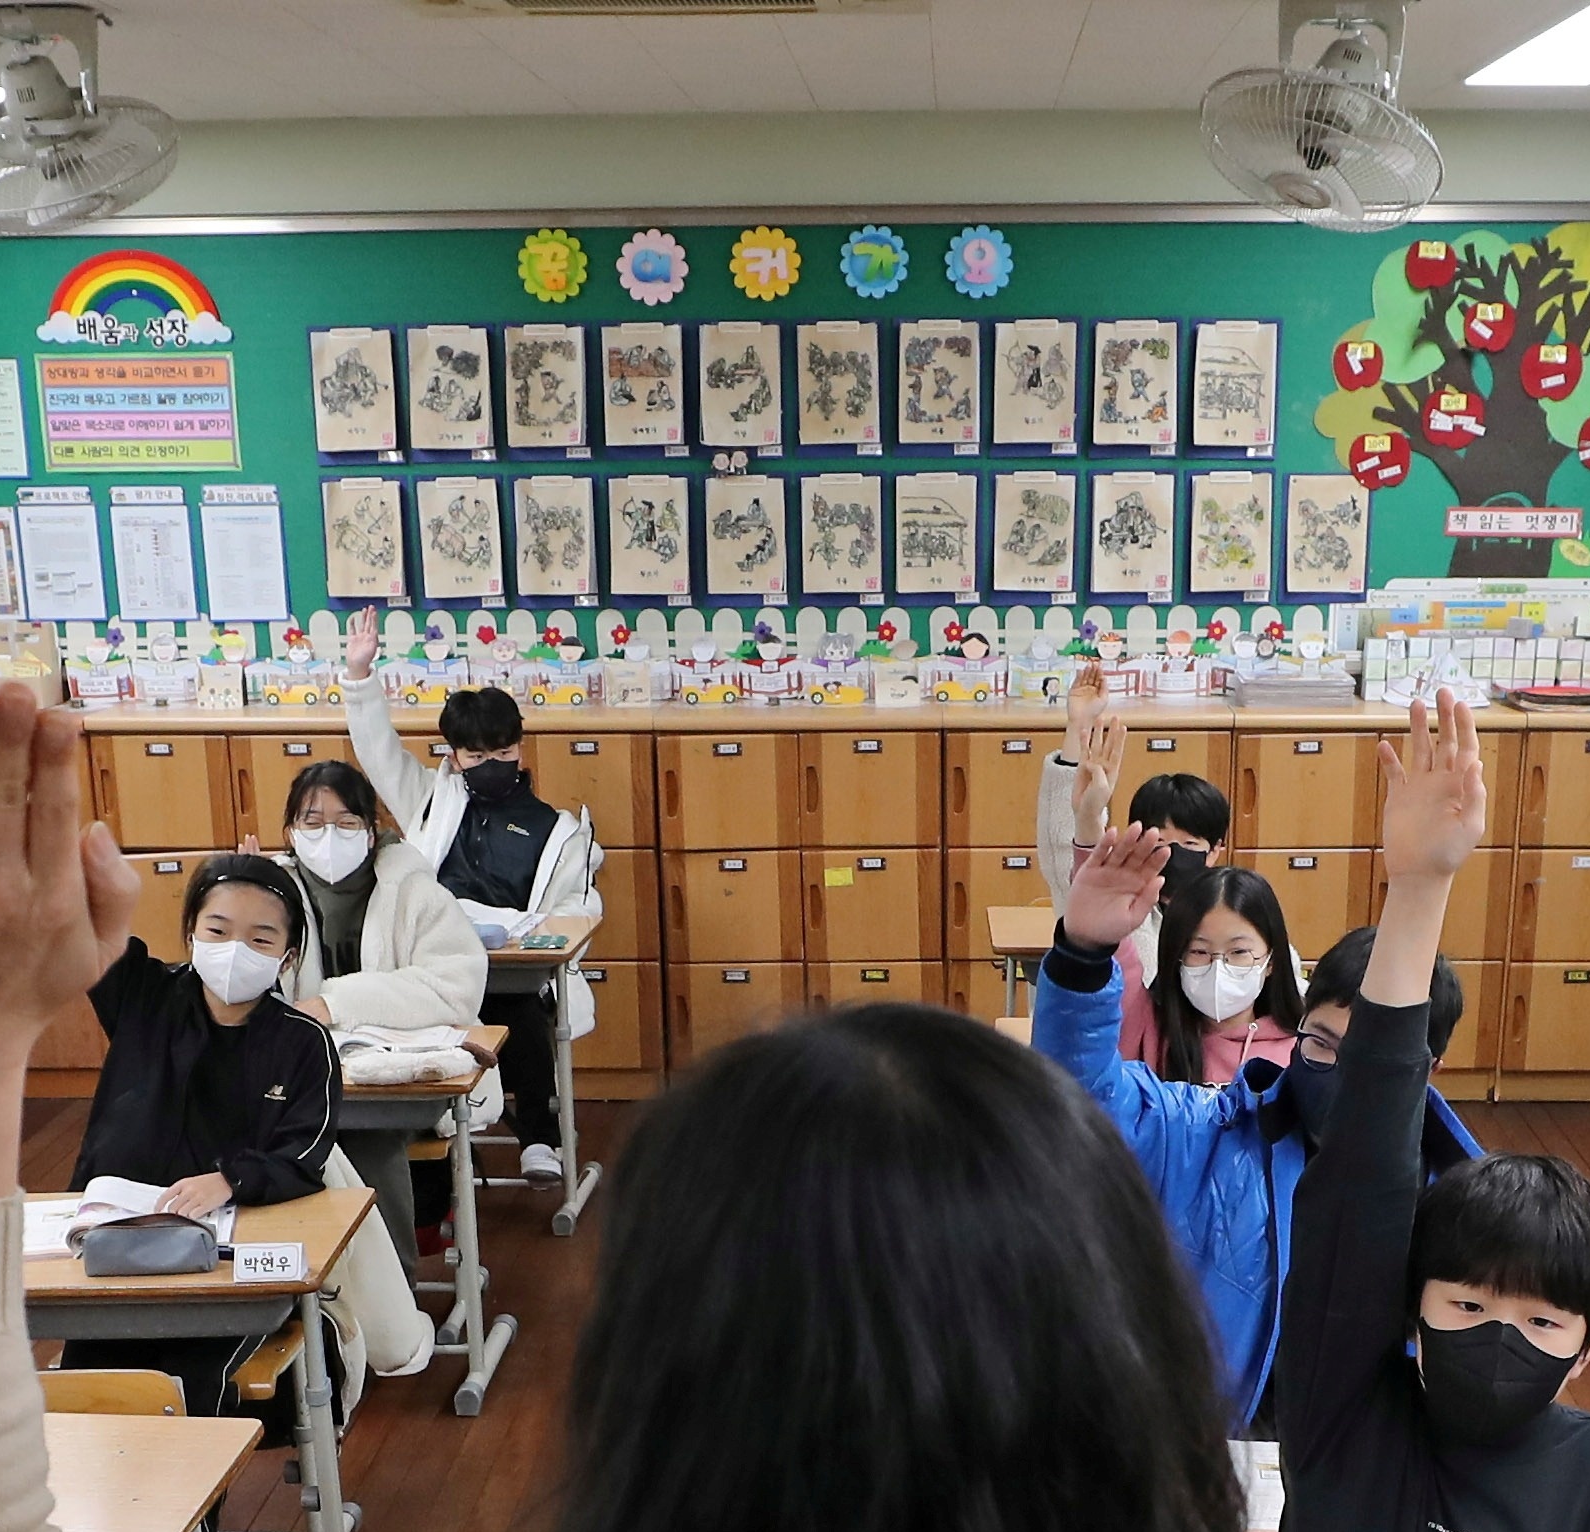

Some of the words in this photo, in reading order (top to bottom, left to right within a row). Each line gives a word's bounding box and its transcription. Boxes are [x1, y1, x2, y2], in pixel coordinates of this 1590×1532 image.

[77, 316, 137, 345] 배움과
[146, 318, 188, 346] 성장
[94, 366, 127, 378] 생각을
[132, 366, 187, 378] 비교하면서
[49, 393, 80, 405] 친구와
[84, 393, 116, 405] 배우고
[54, 446, 74, 458] 다른
[81, 446, 113, 458] 사람의
[119, 446, 140, 458] 의견
[1453, 513, 1468, 530] 책
[1480, 513, 1513, 530] 읽는
[1525, 514, 1575, 531] 멋쟁이
[244, 1257, 291, 1273] 박연우
